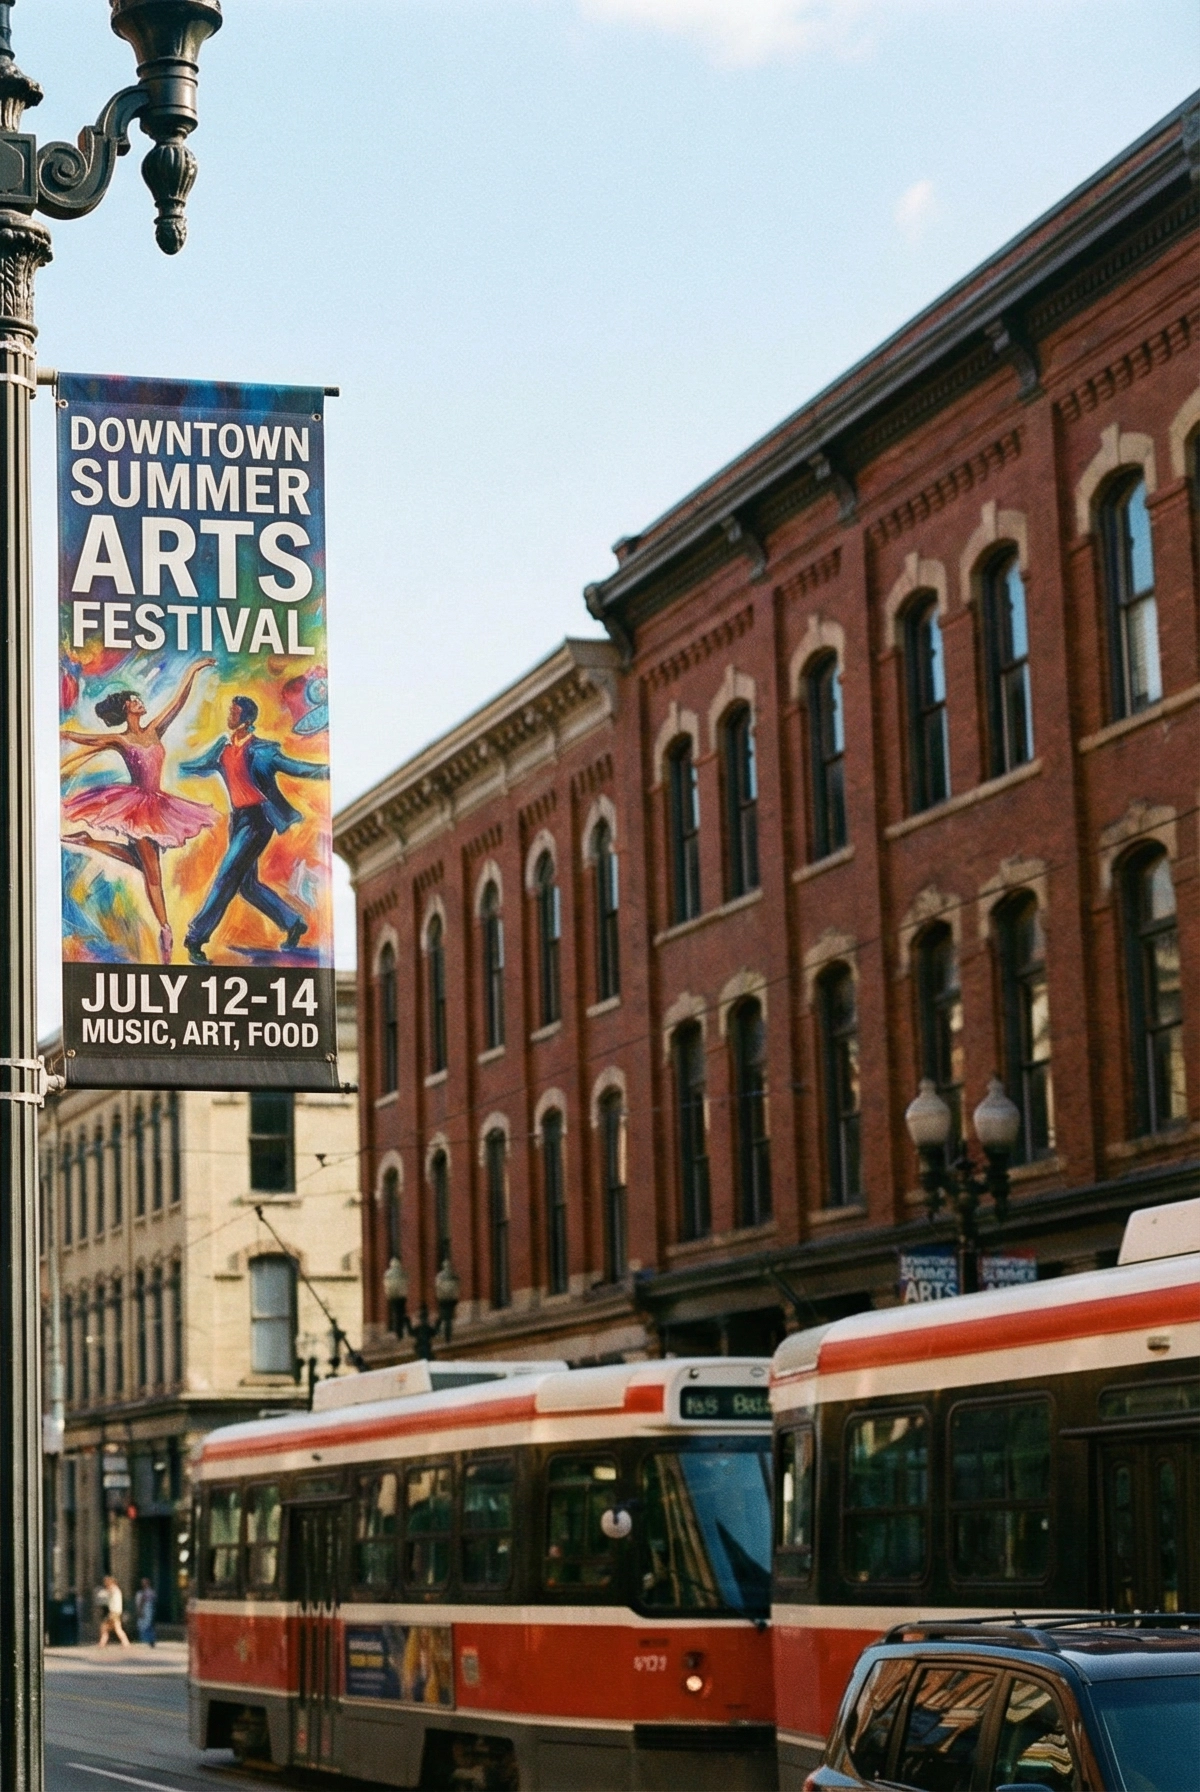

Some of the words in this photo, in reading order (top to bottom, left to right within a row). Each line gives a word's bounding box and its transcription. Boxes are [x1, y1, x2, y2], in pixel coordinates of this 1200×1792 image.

[70, 415, 310, 462] DOWNTOWN
[70, 457, 310, 515] SUMMER
[71, 514, 313, 603] ARTS
[73, 600, 315, 656] FESTIVAL
[81, 971, 188, 1014] JULY
[201, 974, 319, 1018] 12-14
[81, 1017, 176, 1050] MUSIC,
[181, 1019, 240, 1051] ART,
[247, 1021, 319, 1049] FOOD
